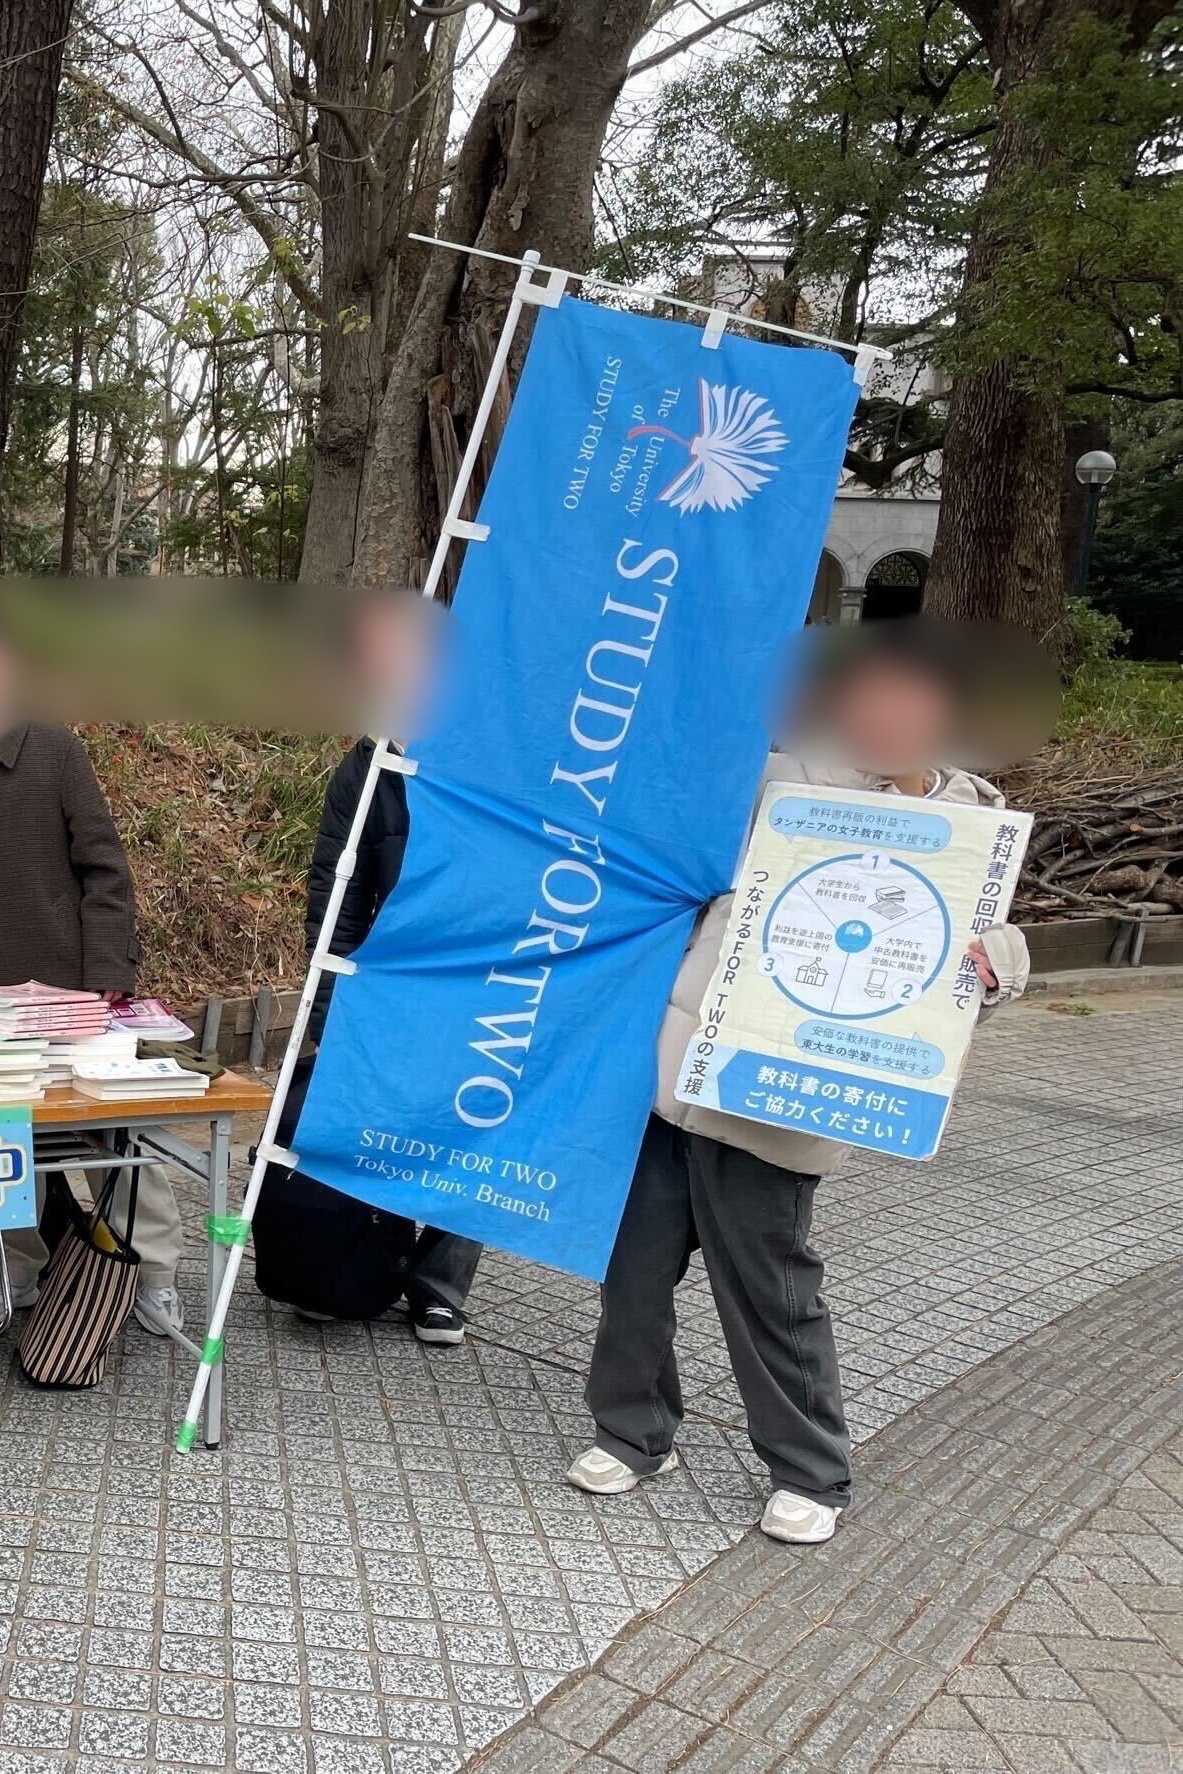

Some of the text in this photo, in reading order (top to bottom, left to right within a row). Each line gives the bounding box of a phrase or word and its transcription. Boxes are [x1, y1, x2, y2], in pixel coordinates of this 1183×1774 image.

[563, 356, 622, 510] STUDY FOR TWO
[610, 404, 646, 493] of Tokyo
[625, 388, 681, 518] The University
[454, 538, 680, 1128] STUDY FOR TWO
[774, 816, 941, 848] タンザニアの女子教育を支援する
[809, 806, 911, 828] 教科書再販の利益で
[871, 855, 880, 870] 1
[816, 888, 867, 903] 教科書を回収
[818, 878, 860, 891] 大学生から
[952, 824, 1019, 1010] 教科書の回収販売で
[874, 946, 928, 962] 中古教科書を
[886, 937, 923, 949] 大学内で
[764, 957, 775, 972] 3
[900, 983, 914, 999] 2
[801, 1038, 930, 1075] 東大生の学習を支援する
[811, 1025, 931, 1058] 安価な教科書の提供で
[756, 1064, 909, 1117] 教科書の寄付に
[360, 1129, 557, 1191] STUDY FOR TWO
[354, 1154, 551, 1222] Tokyo Univ. Branch
